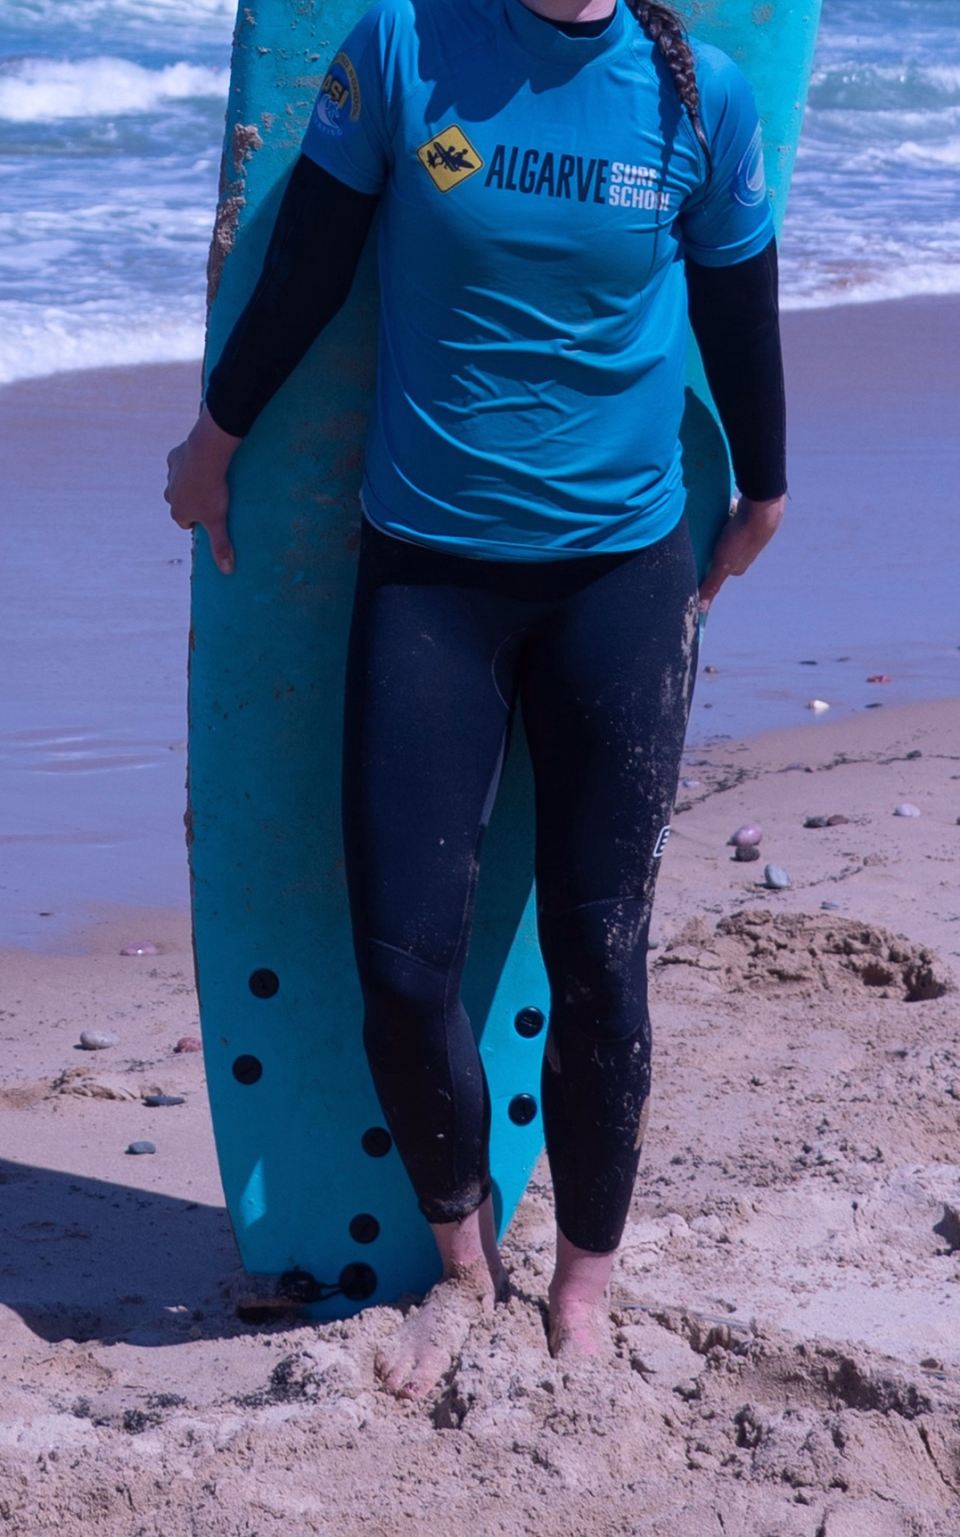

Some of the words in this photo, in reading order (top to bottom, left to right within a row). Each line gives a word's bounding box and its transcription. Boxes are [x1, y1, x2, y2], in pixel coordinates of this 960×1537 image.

[484, 144, 609, 205] ALGARVE
[611, 161, 657, 188] SURF
[608, 184, 670, 211] SCHOOL
